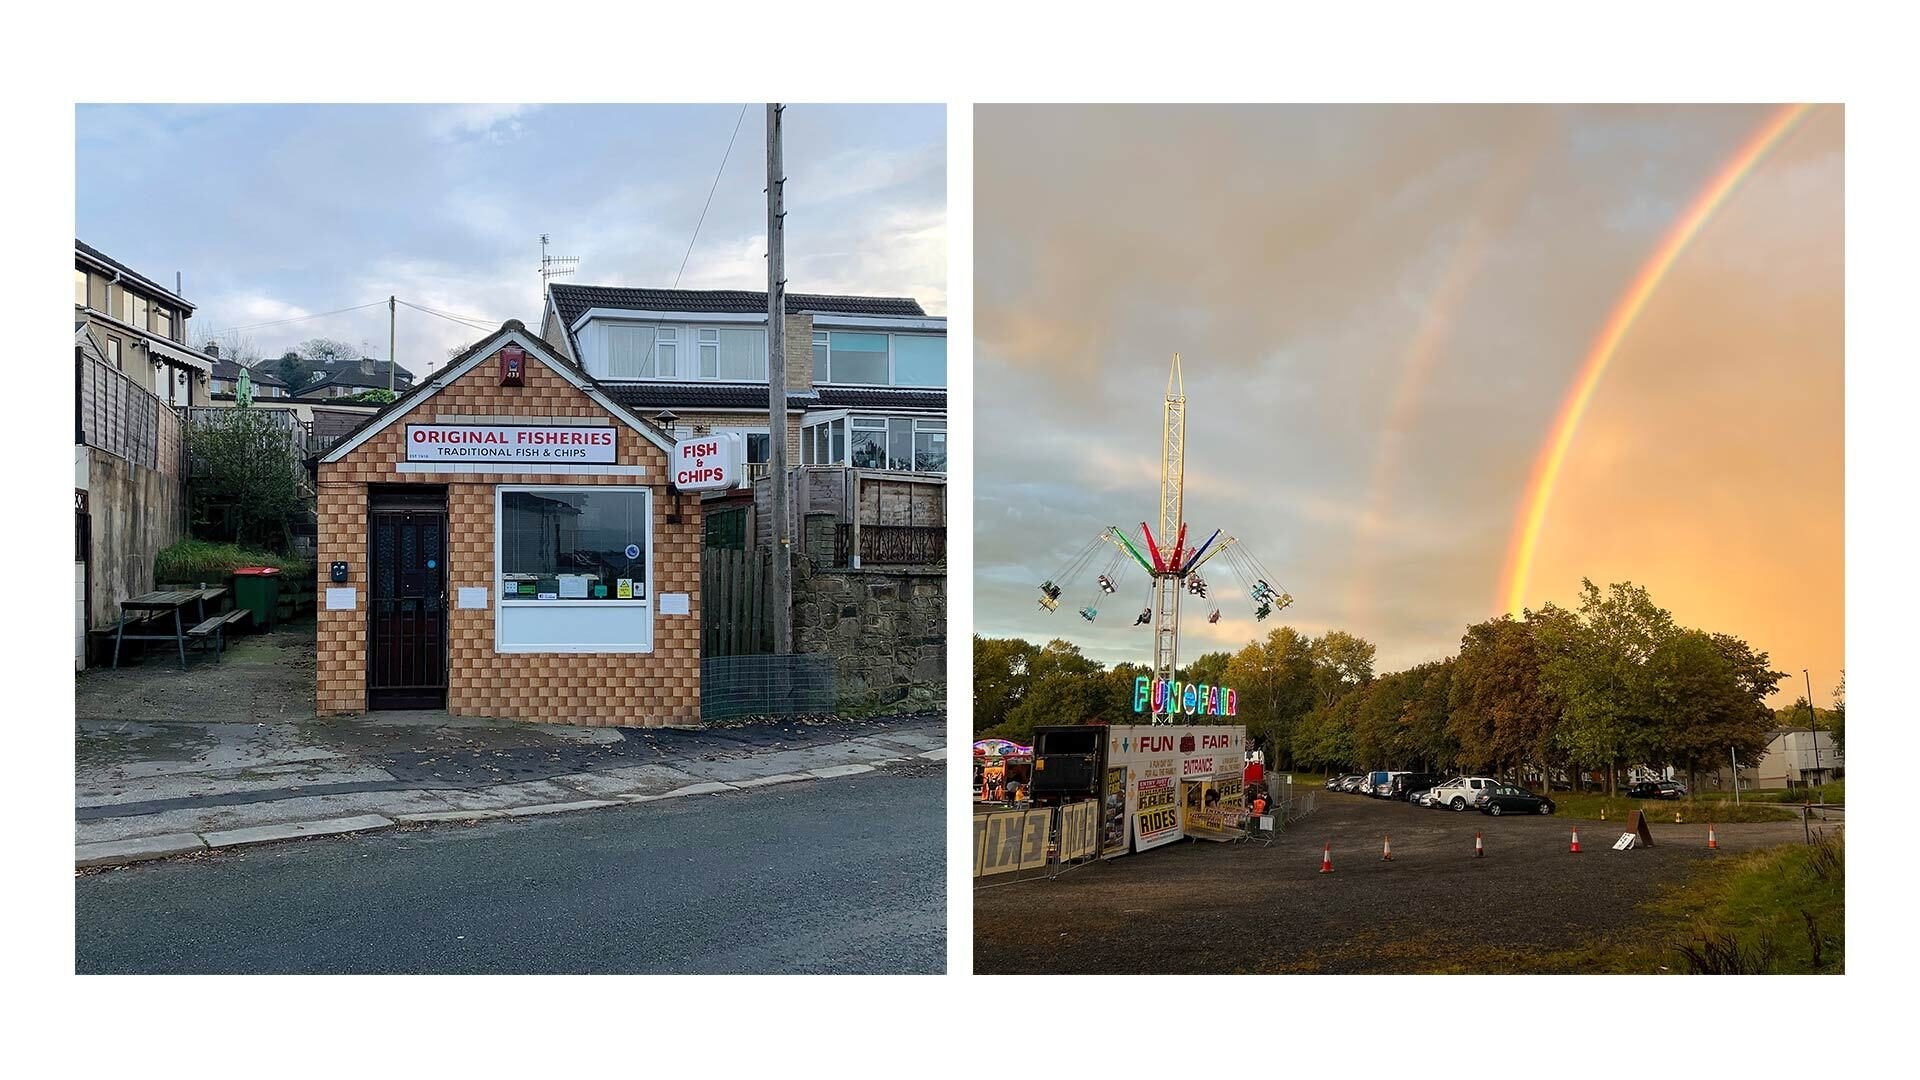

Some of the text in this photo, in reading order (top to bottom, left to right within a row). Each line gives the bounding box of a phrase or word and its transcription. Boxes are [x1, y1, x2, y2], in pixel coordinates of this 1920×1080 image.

[413, 430, 612, 445] ORIGINAL FISHERIES
[437, 447, 586, 457] TRADITIONAL FISH & CHIPS
[683, 442, 717, 458] FISH
[696, 458, 704, 467] &
[677, 467, 723, 484] CHIPS
[1134, 675, 1237, 716] FUN FAIR
[1139, 735, 1229, 753] FUN FAIR
[1184, 757, 1213, 775] ENTRANCE
[1219, 783, 1242, 796] FREE
[1139, 792, 1175, 809] FREE
[1140, 809, 1176, 833] RIDES
